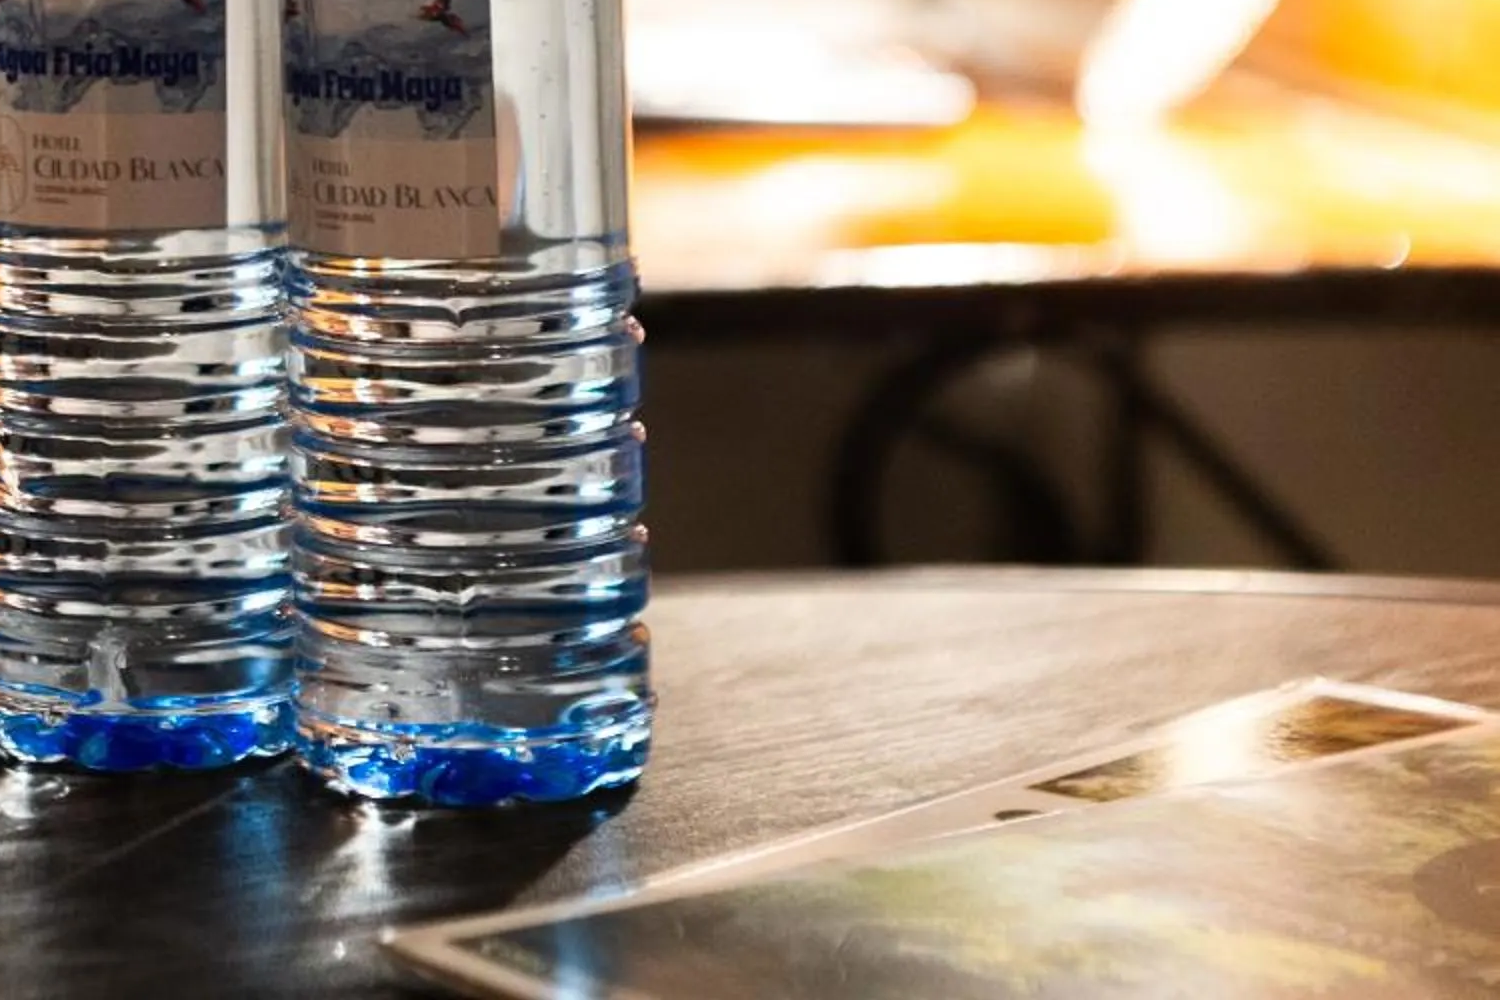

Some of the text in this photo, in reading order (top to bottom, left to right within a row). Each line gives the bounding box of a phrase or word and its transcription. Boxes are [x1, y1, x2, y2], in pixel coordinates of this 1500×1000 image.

[117, 45, 199, 85] Maya
[378, 68, 463, 111] Maya
[33, 154, 225, 183] CIUDAD BLANCA
[313, 179, 497, 209] CIUDAD BLANCA
